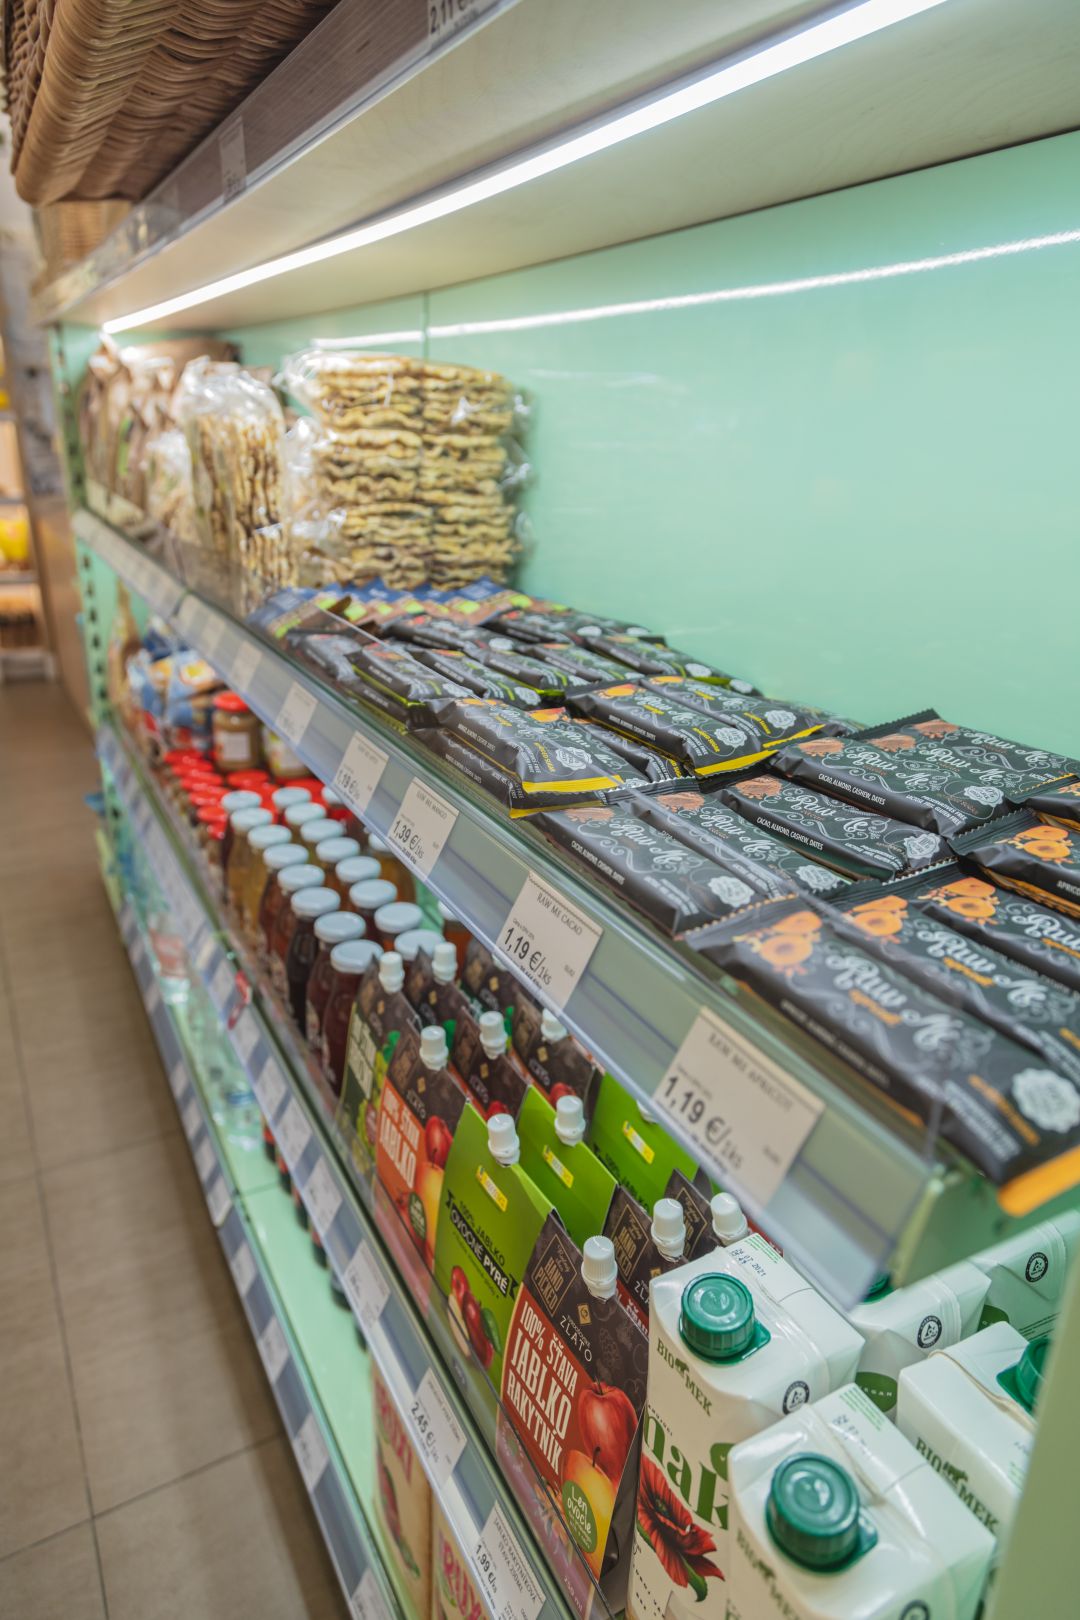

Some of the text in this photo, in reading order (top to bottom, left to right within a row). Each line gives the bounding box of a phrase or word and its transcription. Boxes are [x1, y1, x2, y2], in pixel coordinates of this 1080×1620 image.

[846, 751, 932, 786] Raw Me
[918, 748, 1006, 784] Raw Me
[784, 794, 873, 833] Raw Me
[871, 793, 886, 806] DATES
[393, 820, 412, 843] 1,39
[608, 822, 657, 846] Raw
[700, 813, 746, 836] Raw
[739, 836, 777, 854] Me
[809, 839, 825, 851] DATES
[537, 893, 553, 910] RAW
[560, 914, 583, 937] CACAO
[504, 927, 530, 960] 1,19
[916, 930, 996, 973] Raw
[663, 1076, 706, 1124] 1,19
[476, 1226, 506, 1268] JABLKO
[483, 1255, 509, 1295] PYRÉ
[534, 1266, 559, 1310] PICKED
[543, 1256, 564, 1292] HAND
[520, 1300, 546, 1351] 100%
[546, 1333, 578, 1398] ŠŤAVA
[560, 1315, 593, 1362] ZLATO
[510, 1327, 572, 1440] JABLKO
[656, 1338, 713, 1418] BIO MEK
[506, 1368, 563, 1476] RAKYTNÍK
[571, 1486, 589, 1516] Len
[958, 1483, 999, 1537] MEK
[475, 1544, 491, 1573] 1,99
